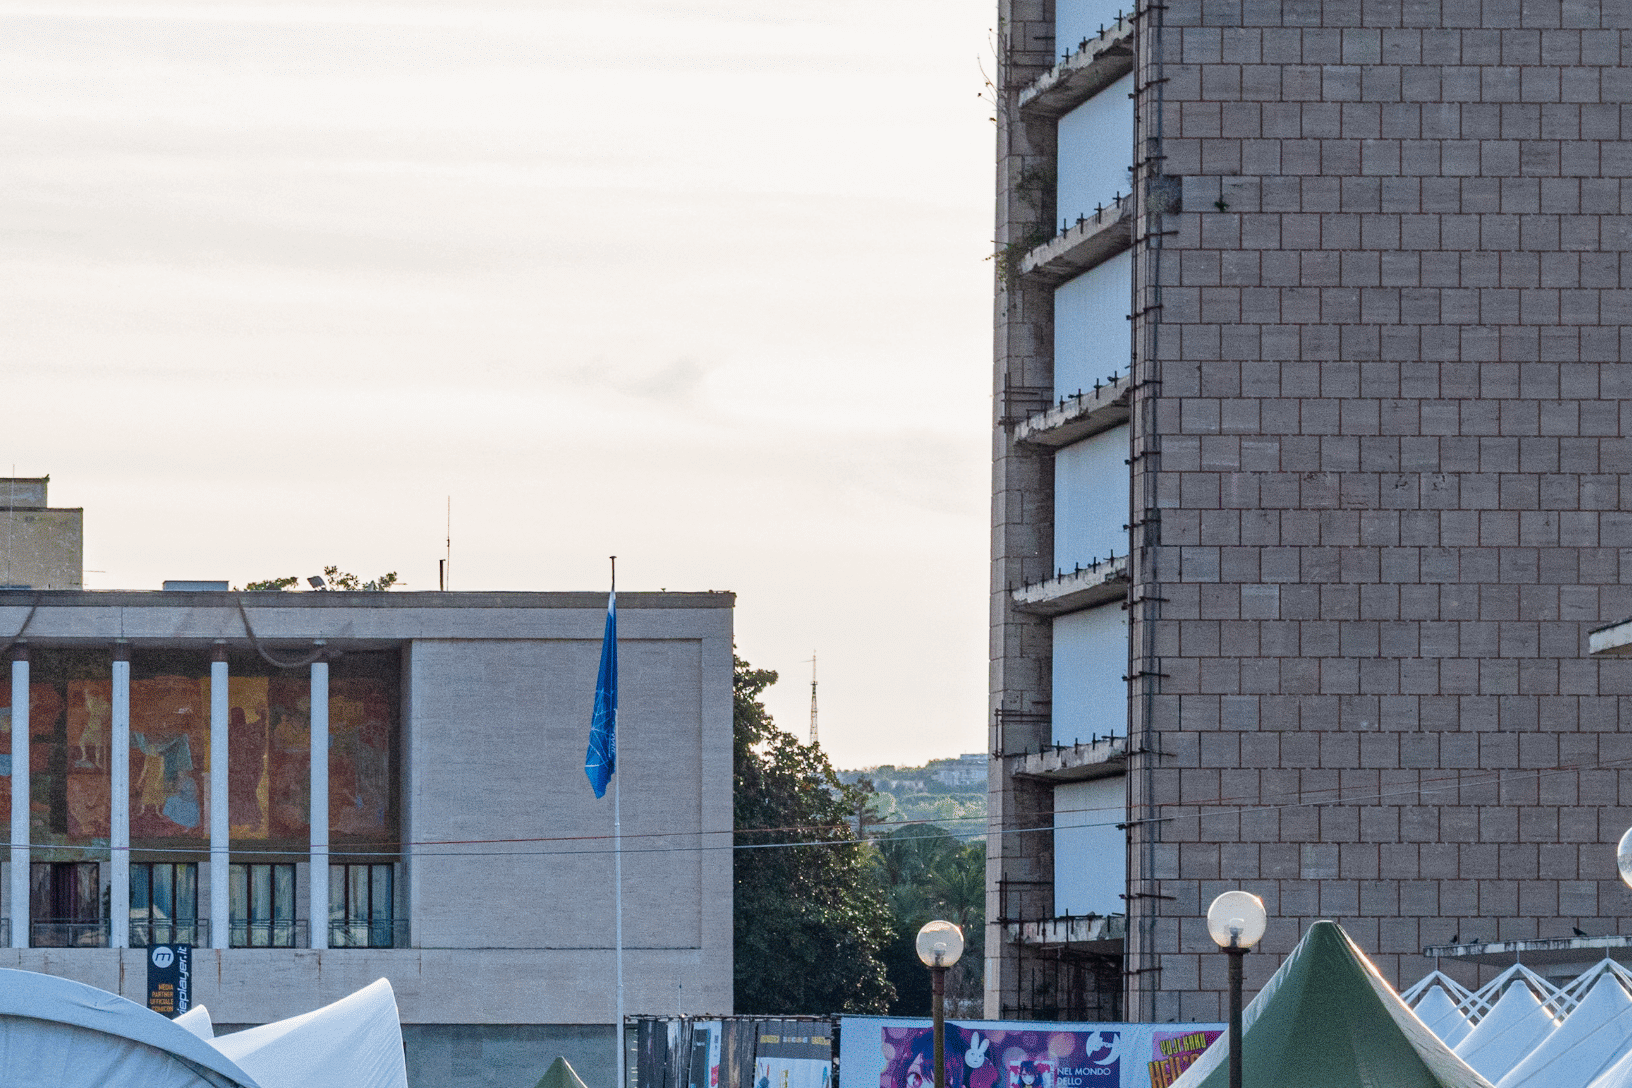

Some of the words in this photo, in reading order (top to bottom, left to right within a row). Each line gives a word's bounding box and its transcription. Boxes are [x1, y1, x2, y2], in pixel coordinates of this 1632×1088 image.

[1057, 1067, 1073, 1076] NEL
[1075, 1067, 1111, 1076] MONDO
[1057, 1077, 1083, 1086] DELLO
